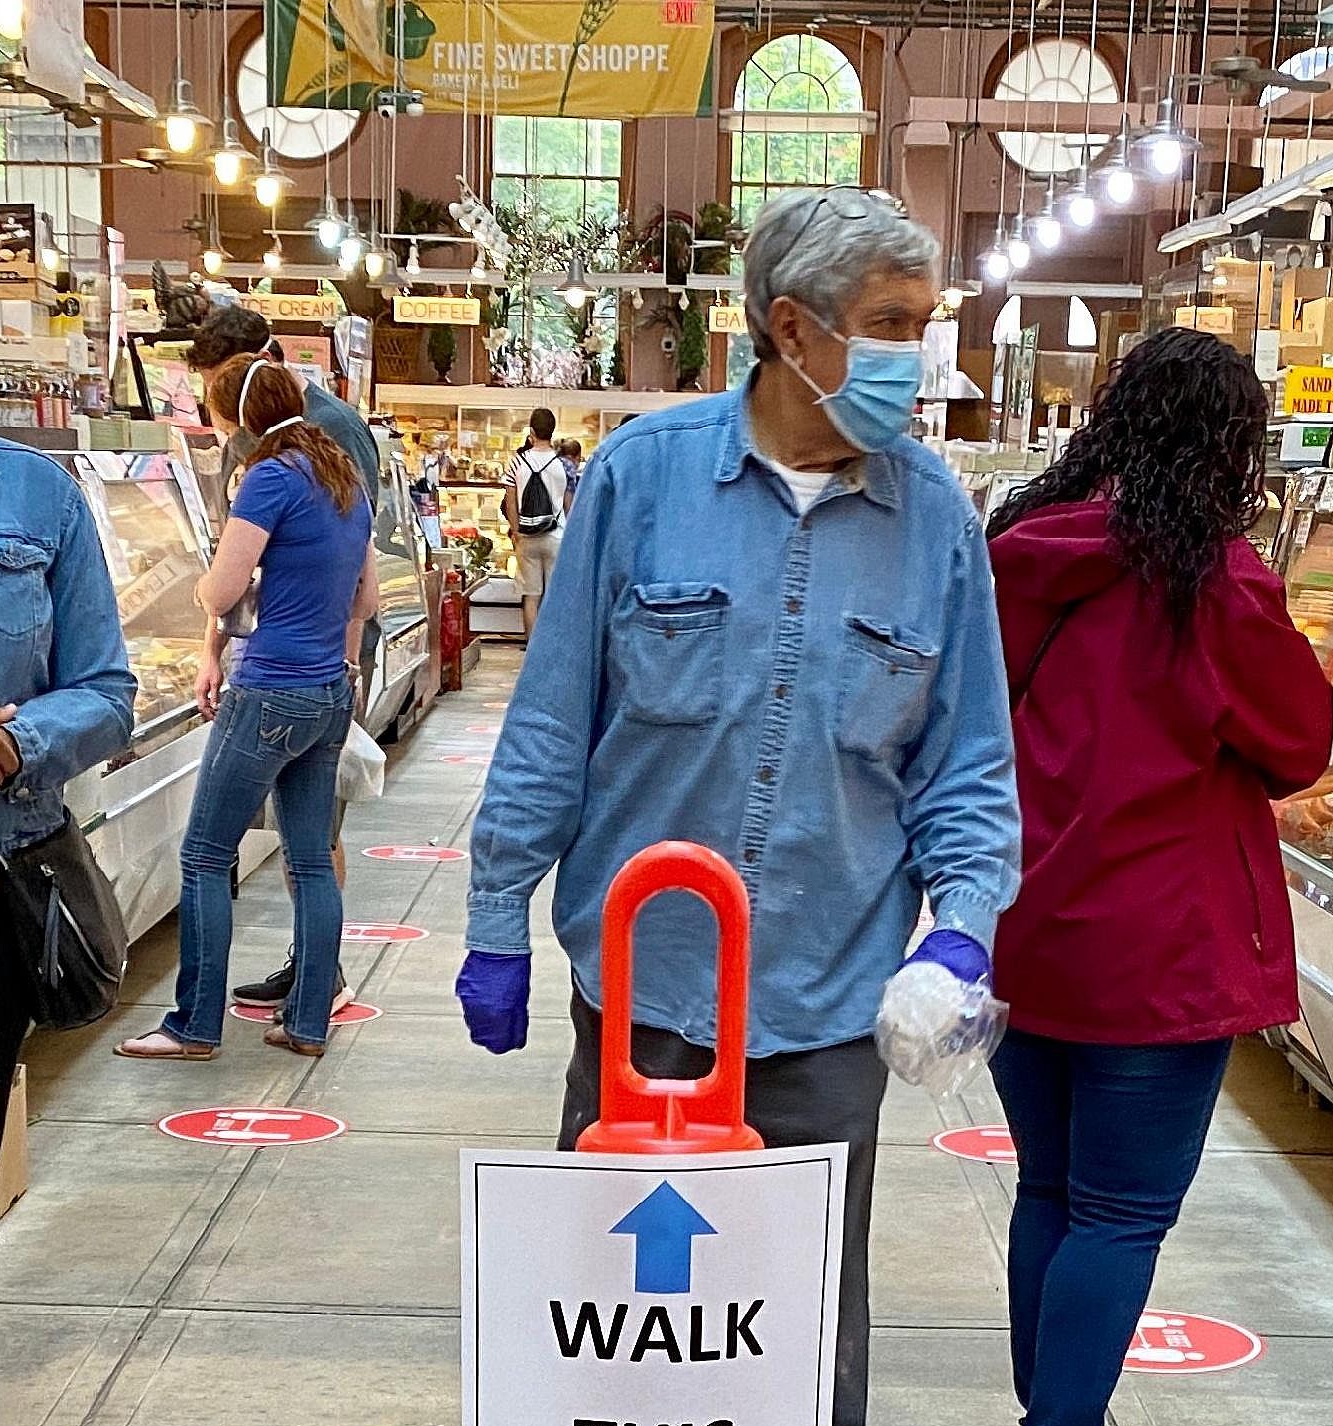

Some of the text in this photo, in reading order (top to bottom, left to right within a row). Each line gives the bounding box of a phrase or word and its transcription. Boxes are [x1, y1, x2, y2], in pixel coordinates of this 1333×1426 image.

[433, 42, 669, 72] FINE SWEET SHOPPE
[278, 299, 334, 317] CREAM
[399, 301, 475, 320] COFFEE
[1291, 398, 1322, 413] MADE
[549, 1299, 765, 1364] WALK
